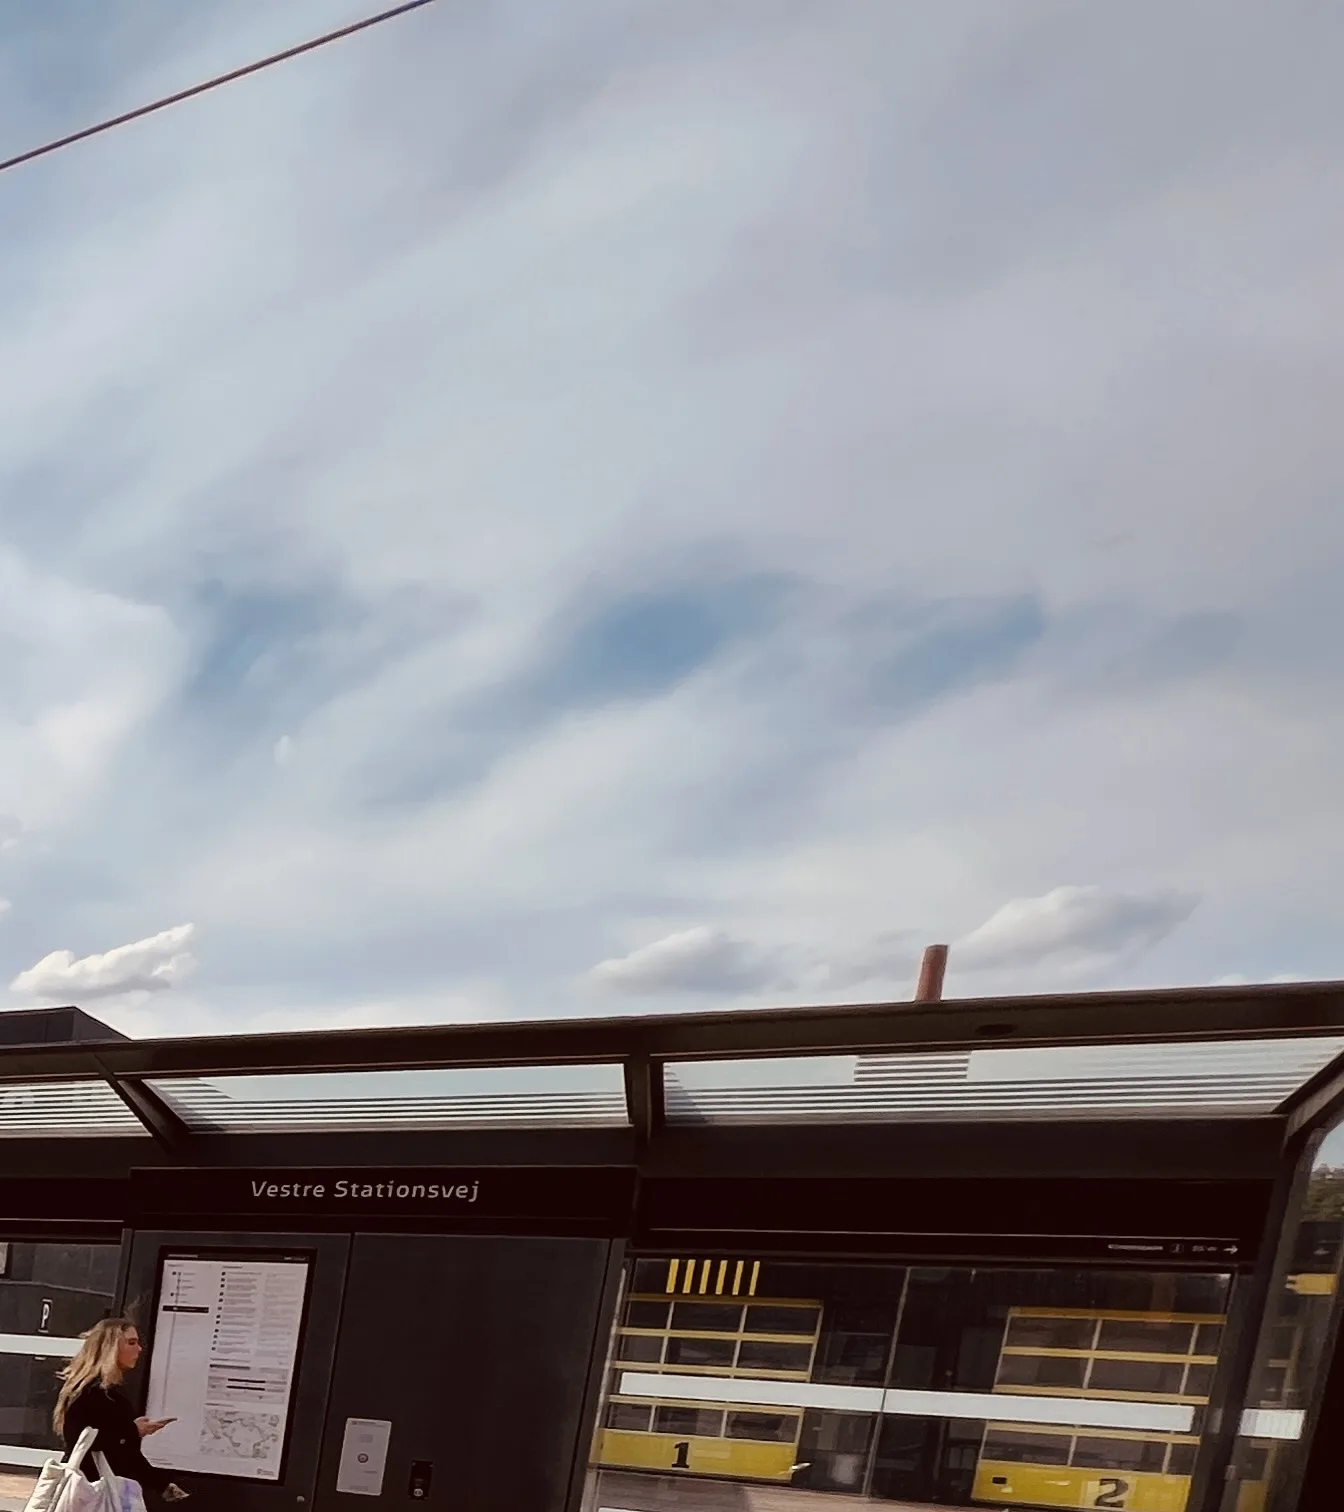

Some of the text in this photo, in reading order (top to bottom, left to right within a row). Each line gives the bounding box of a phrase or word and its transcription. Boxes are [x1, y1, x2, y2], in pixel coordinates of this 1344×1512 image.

[251, 1180, 481, 1203] Vestre Stationsvej
[670, 1441, 691, 1469] 1
[1095, 1477, 1130, 1508] 2
